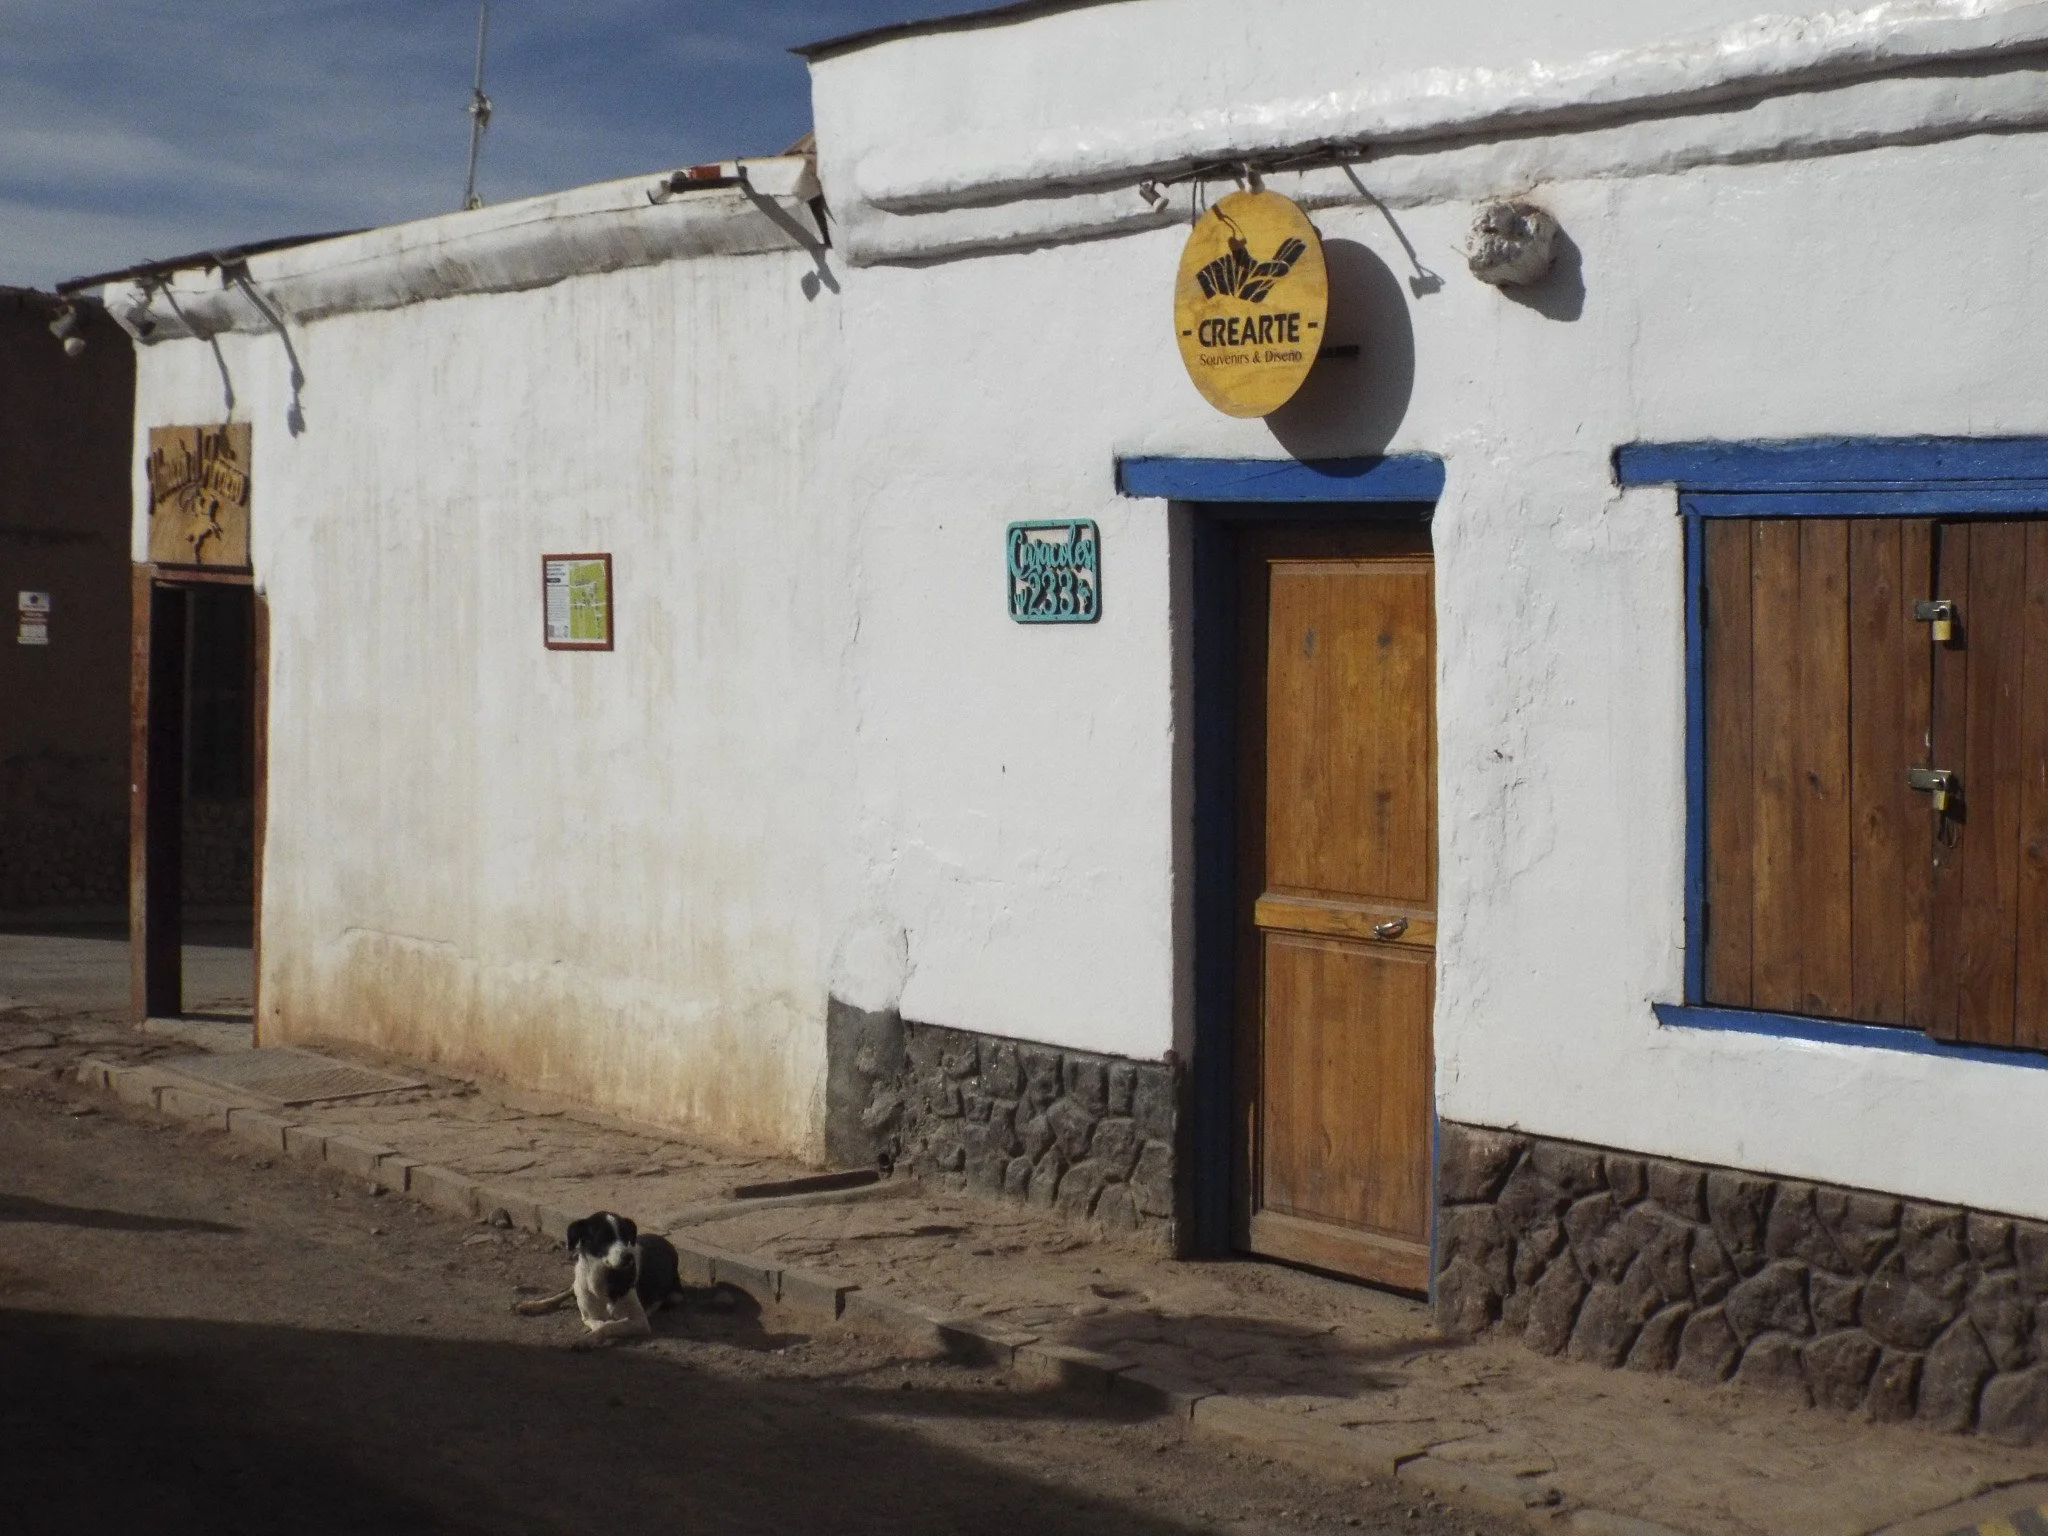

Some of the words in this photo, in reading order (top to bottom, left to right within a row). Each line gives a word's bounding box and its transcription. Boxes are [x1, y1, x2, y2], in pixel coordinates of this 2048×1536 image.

[1198, 312, 1300, 348] CREARTE
[1200, 352, 1250, 367] Souvenirs
[1252, 350, 1261, 364] &
[1027, 569, 1075, 616] 233
